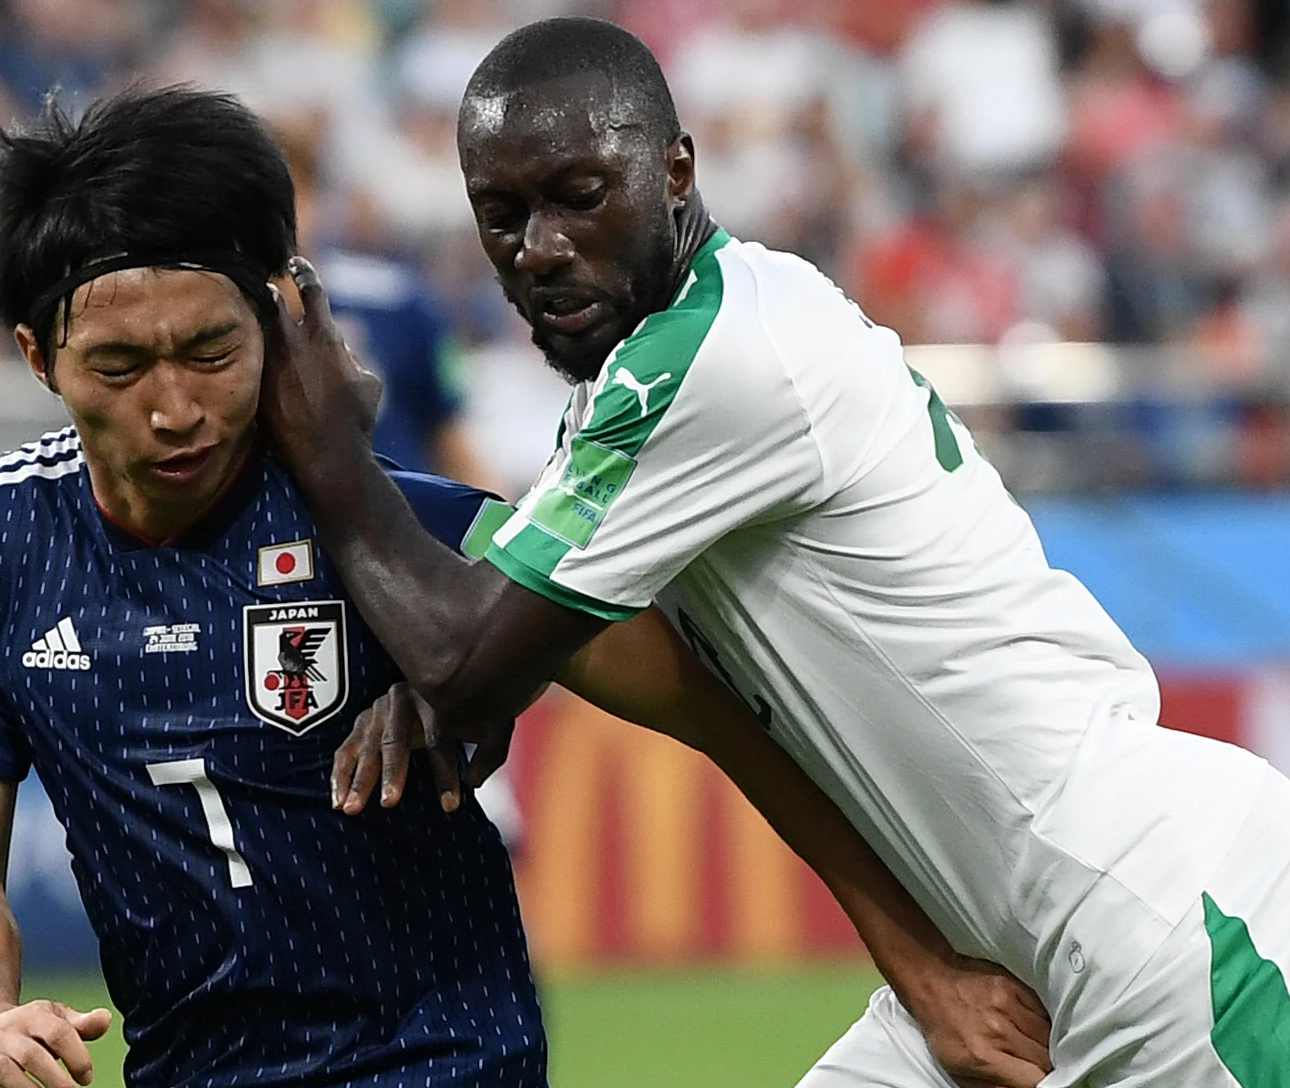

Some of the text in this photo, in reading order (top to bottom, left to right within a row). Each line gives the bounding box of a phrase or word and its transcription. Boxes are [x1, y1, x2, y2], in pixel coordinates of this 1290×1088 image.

[572, 503, 596, 522] FIFA
[268, 607, 319, 621] JAPAN
[22, 650, 91, 671] adidas
[273, 689, 319, 711] JFA
[146, 757, 253, 889] 7
